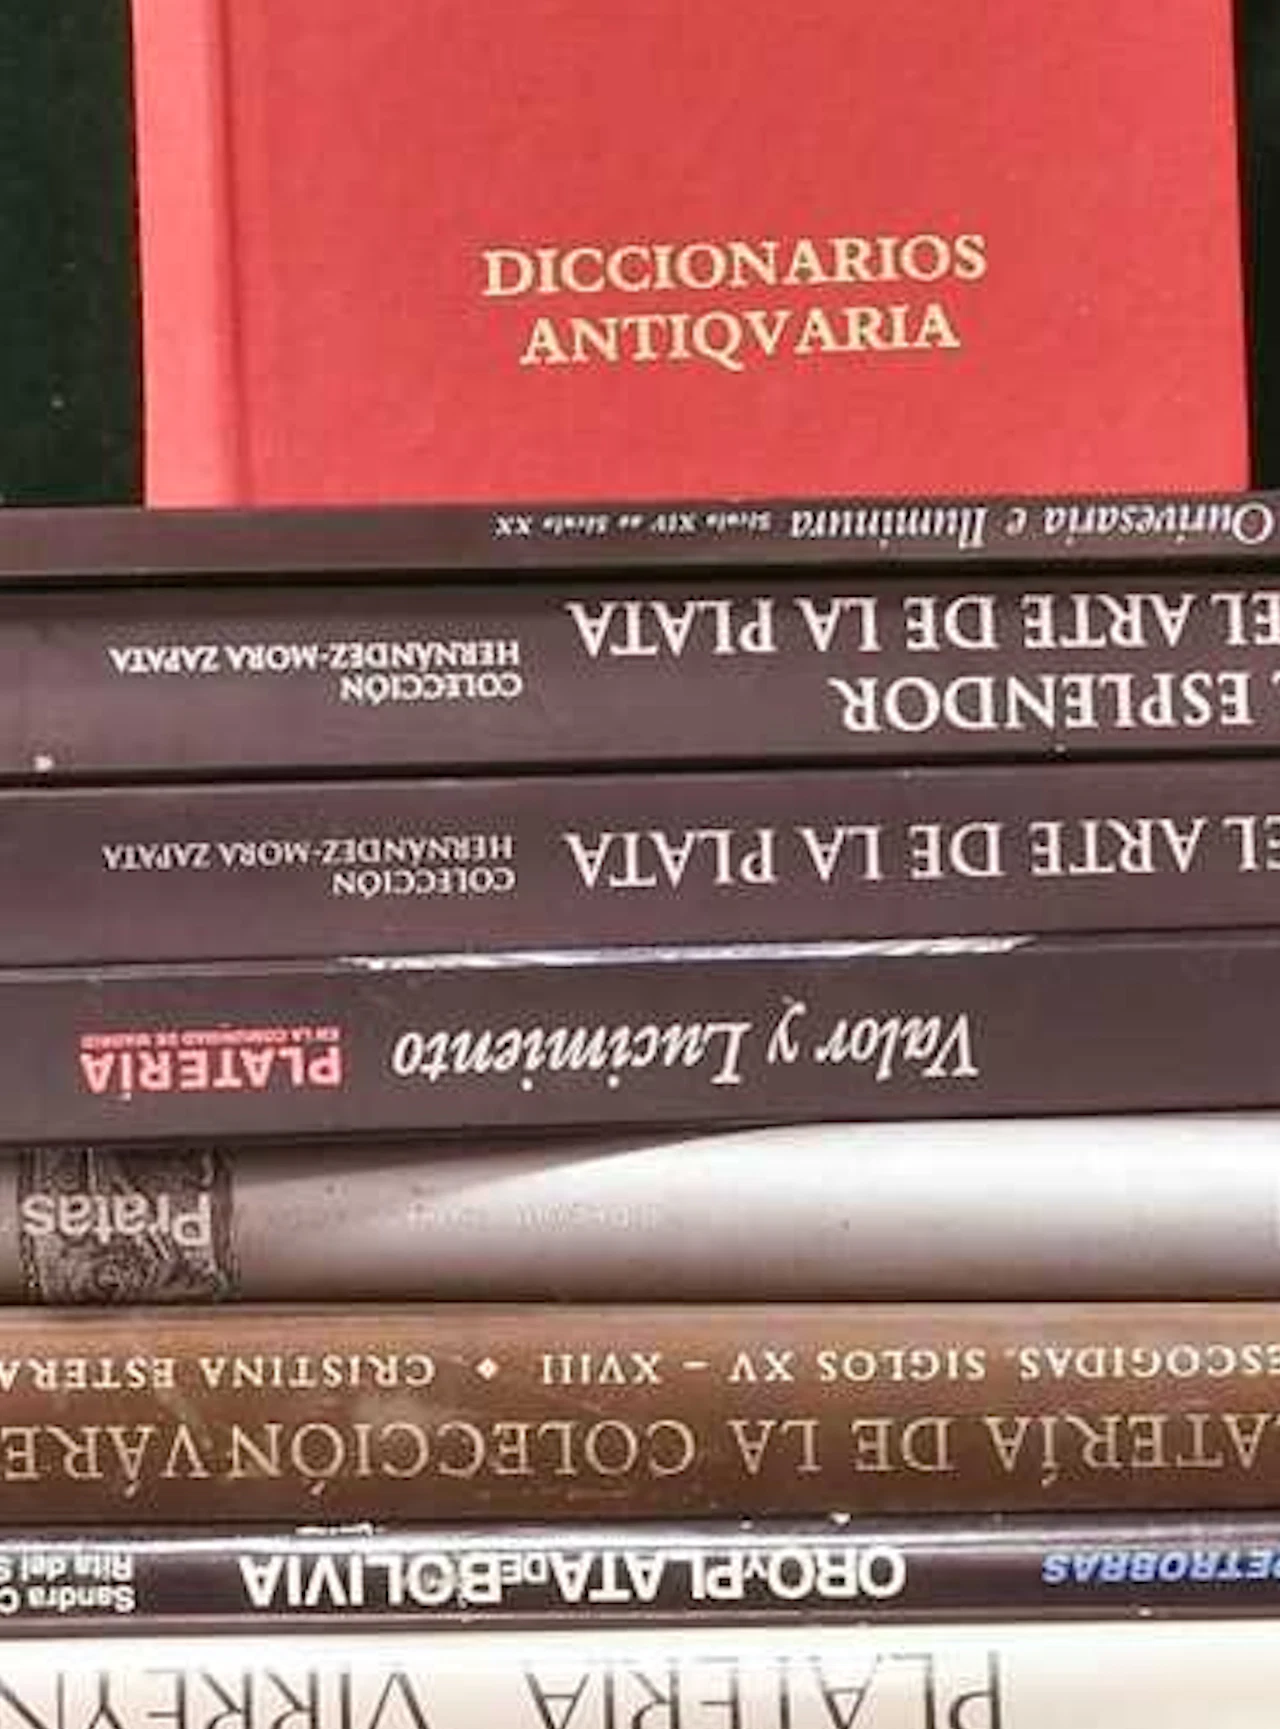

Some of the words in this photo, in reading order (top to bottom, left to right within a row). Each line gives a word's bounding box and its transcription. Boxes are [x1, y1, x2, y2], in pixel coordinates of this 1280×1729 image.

[482, 233, 987, 297] DICCIONARIOS
[520, 303, 961, 371] ANTIQVARIA
[492, 514, 534, 537] XX
[790, 506, 989, 549] Iluminura
[1007, 507, 1028, 531] e
[1044, 502, 1274, 547] Ourivesaria
[565, 597, 776, 657] PLATA
[794, 595, 879, 654] LA
[903, 594, 997, 652] DE
[1022, 592, 1194, 650] ARTE
[108, 645, 218, 673] ZAPATA
[220, 639, 521, 673] HERNÁNDEZ-MORA
[339, 671, 523, 704] COLECCIÓN
[827, 671, 1252, 732] ESPLENDOR
[101, 842, 211, 870] ZAPATA
[217, 834, 514, 868] HERNÁNDEZ-MORA
[564, 828, 778, 887] PLATA
[797, 824, 883, 882] LA
[909, 821, 1002, 879] DE
[1030, 819, 1208, 875] ARTE
[332, 865, 516, 897] COLECCIÓN
[391, 1020, 752, 1091] Lucimiento
[766, 996, 807, 1064] y
[814, 1012, 979, 1082] Valor
[79, 1046, 342, 1101] PLATERÍA
[21, 1191, 213, 1247] Pratas
[200, 1353, 436, 1389] CRISTINA
[541, 1351, 660, 1386] XVIII
[726, 1350, 794, 1384] XV
[816, 1347, 986, 1383] SIGLOS
[227, 1419, 696, 1496] COLECCIÓN
[727, 1417, 820, 1475] LA
[849, 1416, 955, 1473] DE
[21, 1555, 67, 1583] del
[74, 1554, 133, 1582] Rita
[238, 1553, 502, 1608] BOLIVIA
[27, 1584, 136, 1614] Sandra
